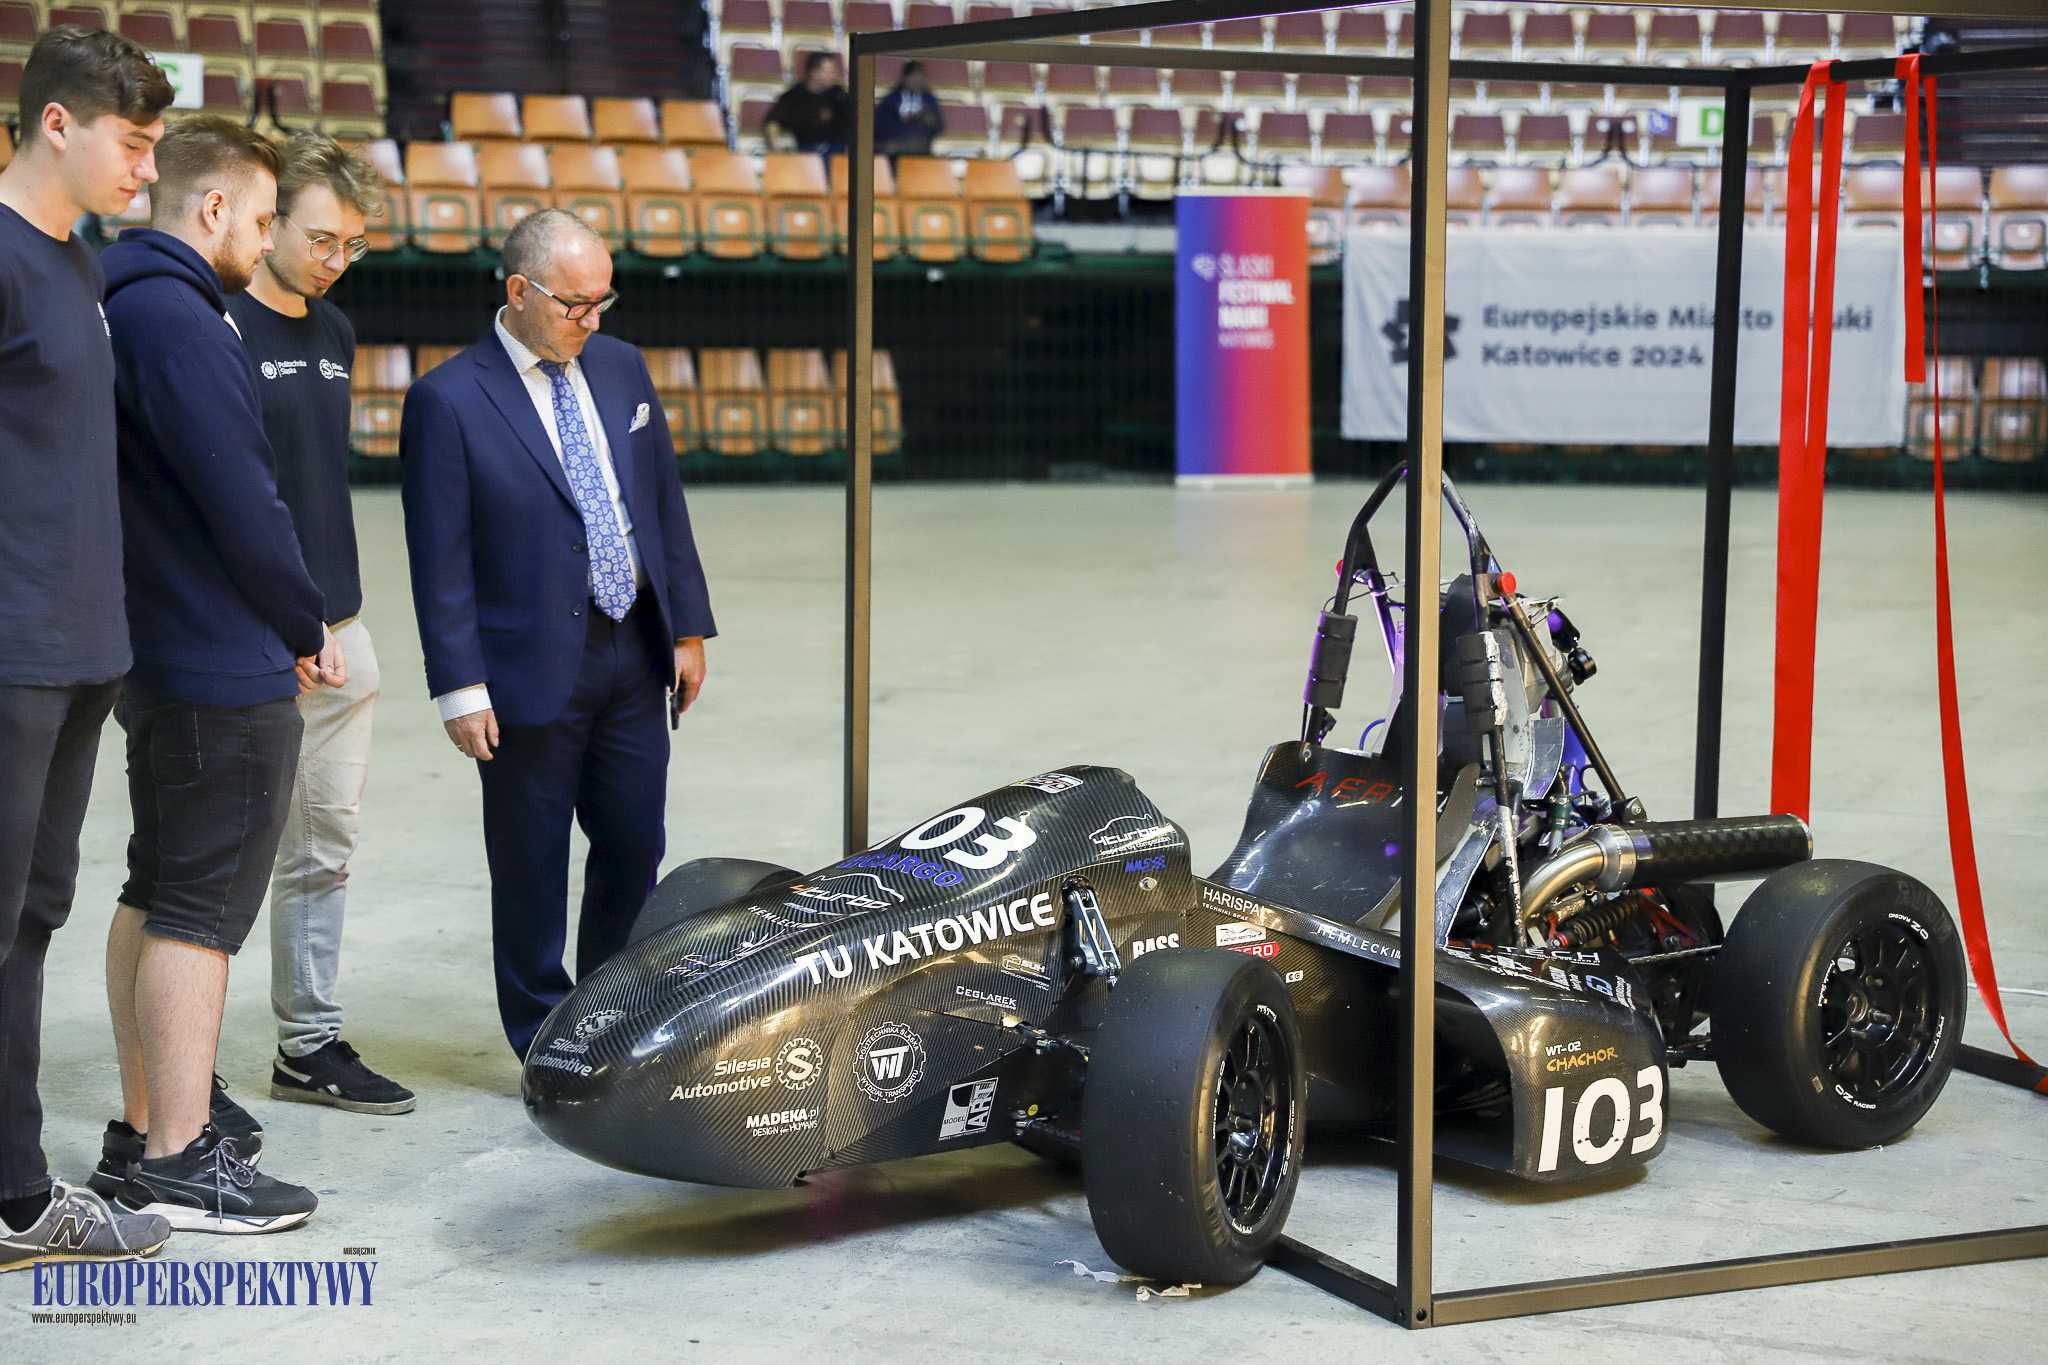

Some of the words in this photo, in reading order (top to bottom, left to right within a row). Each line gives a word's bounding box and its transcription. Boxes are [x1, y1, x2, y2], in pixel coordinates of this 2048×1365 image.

[1482, 304, 1658, 334] Europejskie
[1668, 306, 1774, 329] Miato
[1481, 343, 1621, 368] Katowice
[1631, 345, 1705, 368] 2024
[794, 944, 853, 985] TU
[862, 891, 1056, 970] KATOWICE
[956, 985, 1016, 1007] CEGLAREK
[1545, 1040, 1582, 1057] WT-02
[1546, 1047, 1619, 1073] CHACHOR
[714, 1056, 772, 1078] Silesia
[668, 1075, 772, 1101] Automotive
[1538, 1065, 1663, 1173] 103
